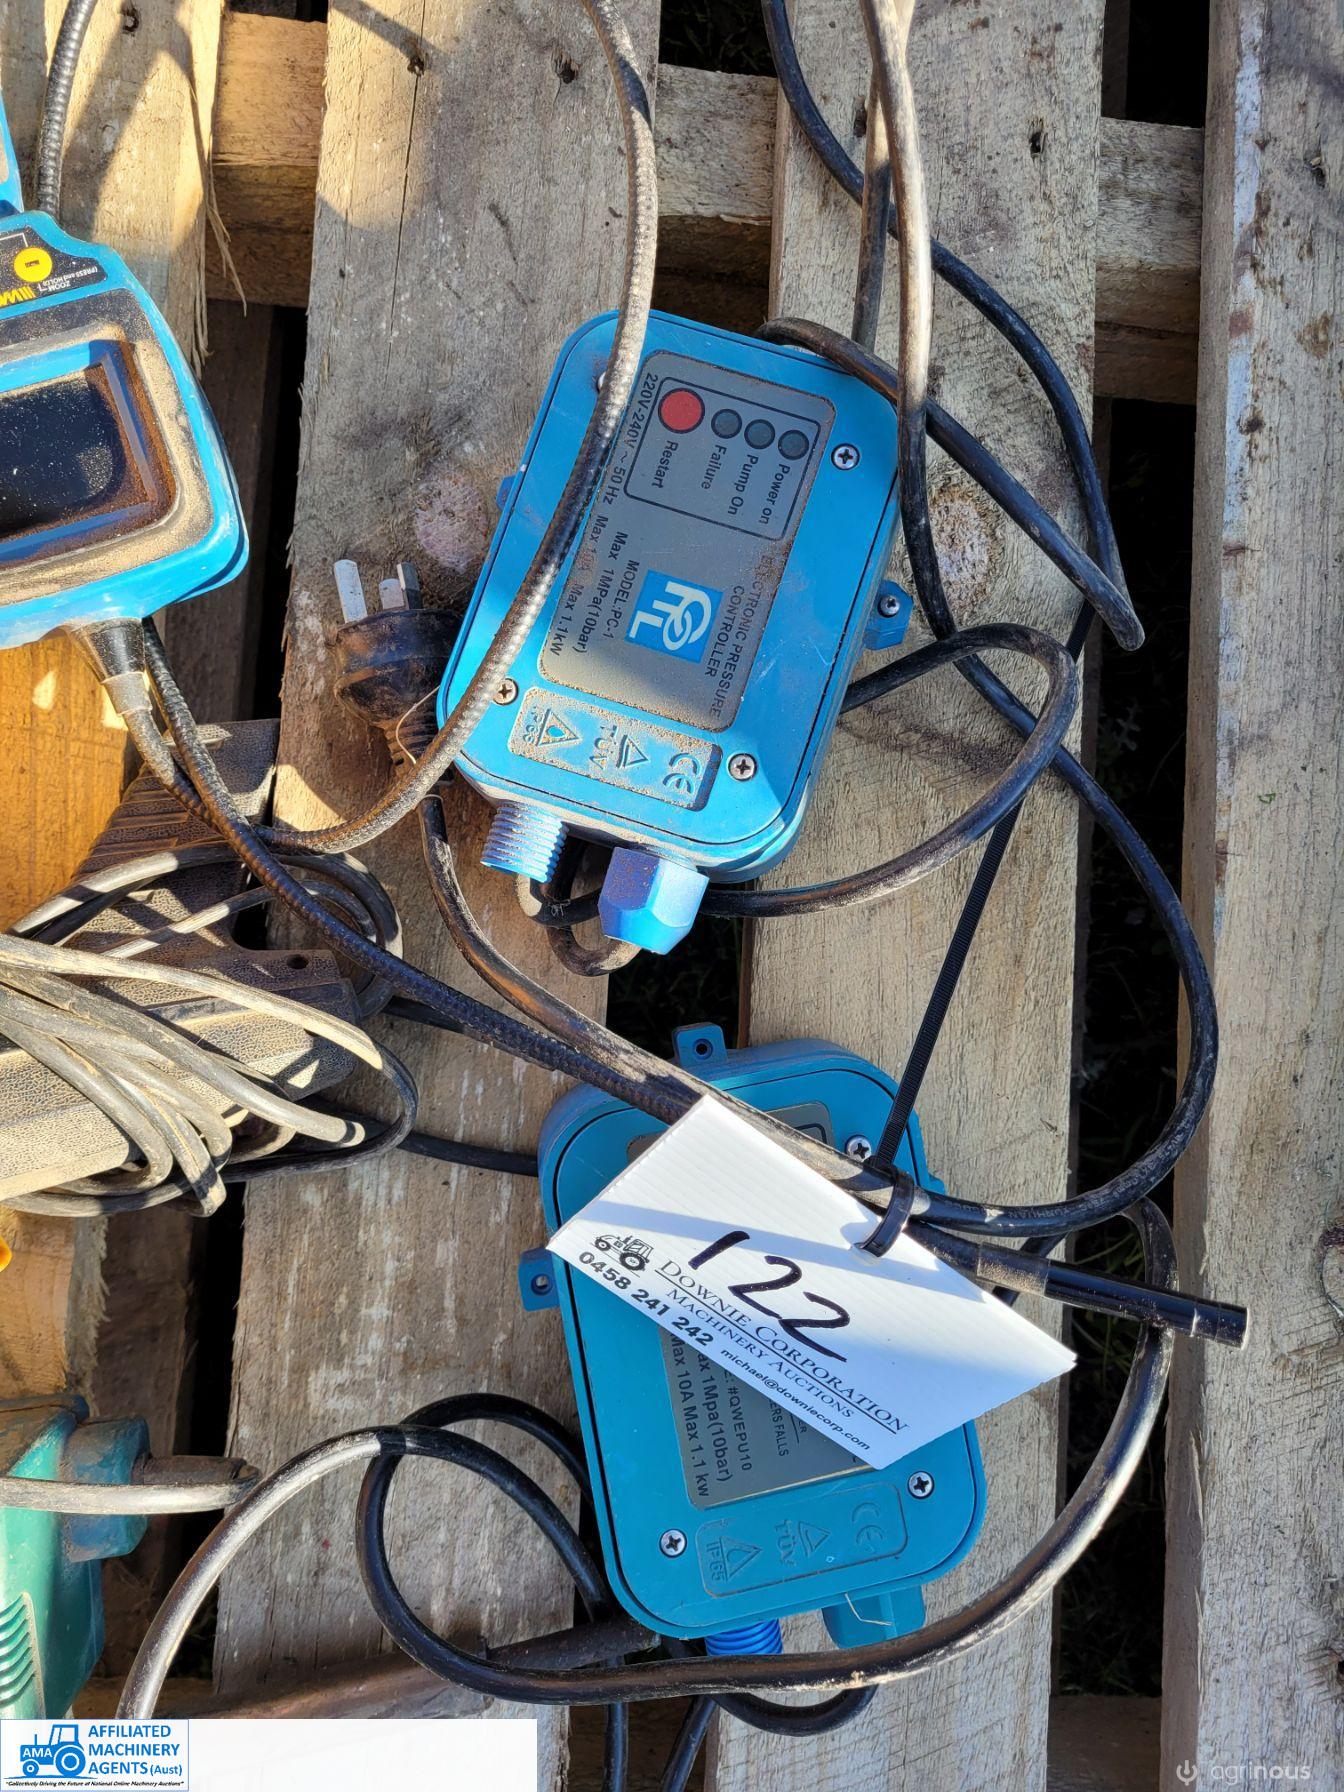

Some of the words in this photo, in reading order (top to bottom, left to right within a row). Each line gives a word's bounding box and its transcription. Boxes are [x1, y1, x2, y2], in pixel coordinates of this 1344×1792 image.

[48, 280, 71, 292] ZOOM
[651, 440, 679, 489] Restart
[701, 444, 727, 490] Failure
[734, 454, 759, 493] Pump
[768, 463, 791, 506] Power
[728, 496, 744, 516] On
[758, 508, 773, 526] on
[590, 515, 608, 544] Max
[608, 531, 629, 560] Max
[565, 583, 584, 610] Max
[573, 569, 615, 654] 1MPa(10bar)
[602, 559, 640, 640] MODEL:PC-1
[550, 615, 573, 656] 1.1kW
[704, 585, 745, 677] CONTROLLER
[709, 643, 744, 720] PRESSURE
[662, 752, 700, 794] CE
[688, 1230, 851, 1363] 122
[578, 1251, 632, 1291] 0458
[631, 1288, 671, 1317] 241
[671, 1316, 714, 1347] 242
[720, 1349, 871, 1451] michael@downiecorp.com
[697, 1352, 712, 1373] ax
[677, 1370, 695, 1403] 10A
[683, 1407, 699, 1442] Max
[702, 1375, 733, 1482] 1Mpa(10bar)
[727, 1386, 752, 1471] #QWEPU10
[776, 1424, 790, 1457] FALLS
[689, 1445, 707, 1474] 1.1
